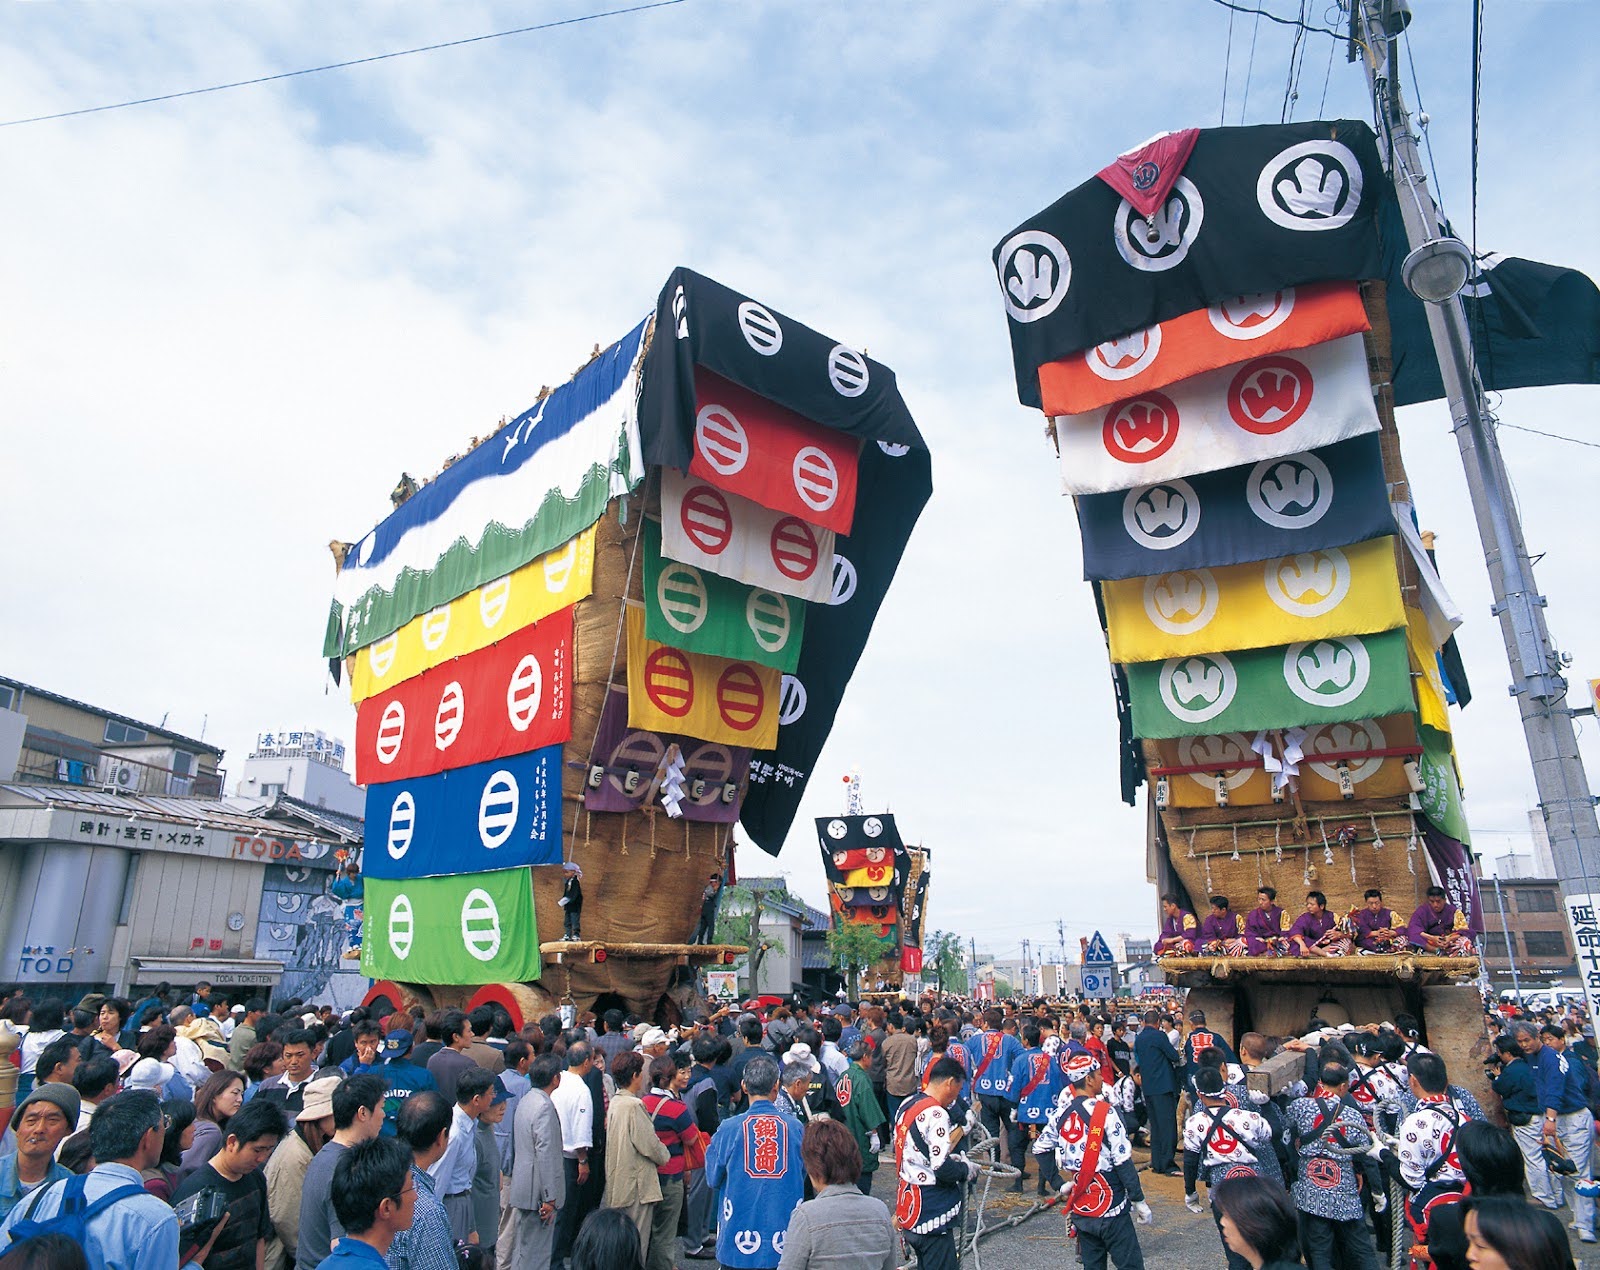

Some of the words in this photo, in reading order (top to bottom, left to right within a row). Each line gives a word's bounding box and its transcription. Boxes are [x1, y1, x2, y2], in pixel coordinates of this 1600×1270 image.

[233, 836, 303, 861] TODA
[20, 957, 74, 974] TOD
[215, 974, 235, 983] TODA
[237, 975, 272, 984] TOKEITEN
